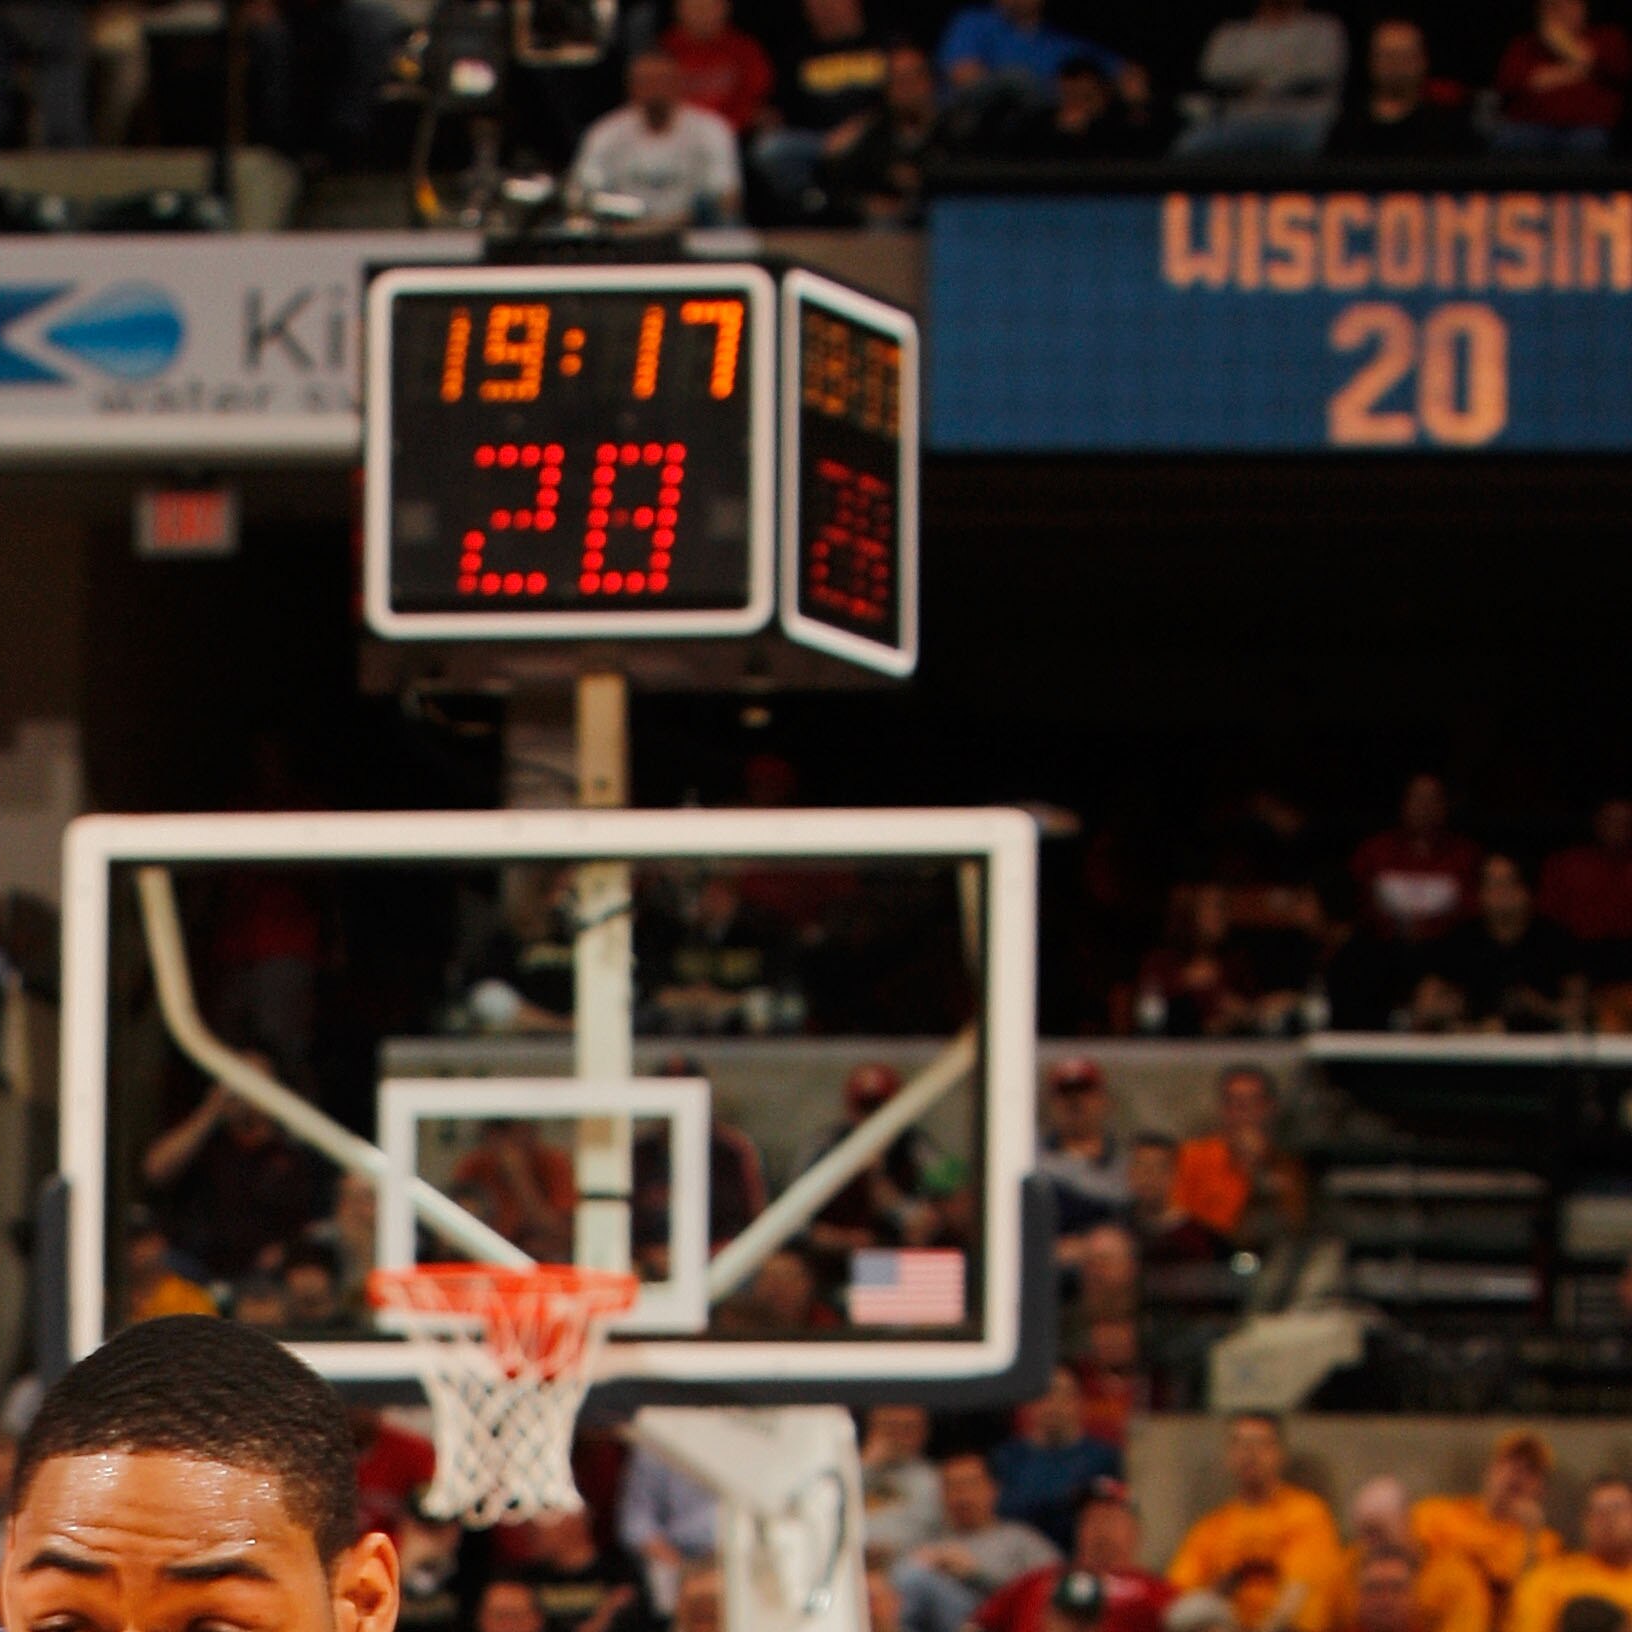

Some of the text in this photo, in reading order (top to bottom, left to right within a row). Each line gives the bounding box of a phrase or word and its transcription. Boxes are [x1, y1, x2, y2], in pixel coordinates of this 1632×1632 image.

[1160, 190, 1632, 293] WISCONSIN
[440, 299, 745, 402] 19:17
[1325, 301, 1509, 447] 20
[457, 441, 687, 596] 28
